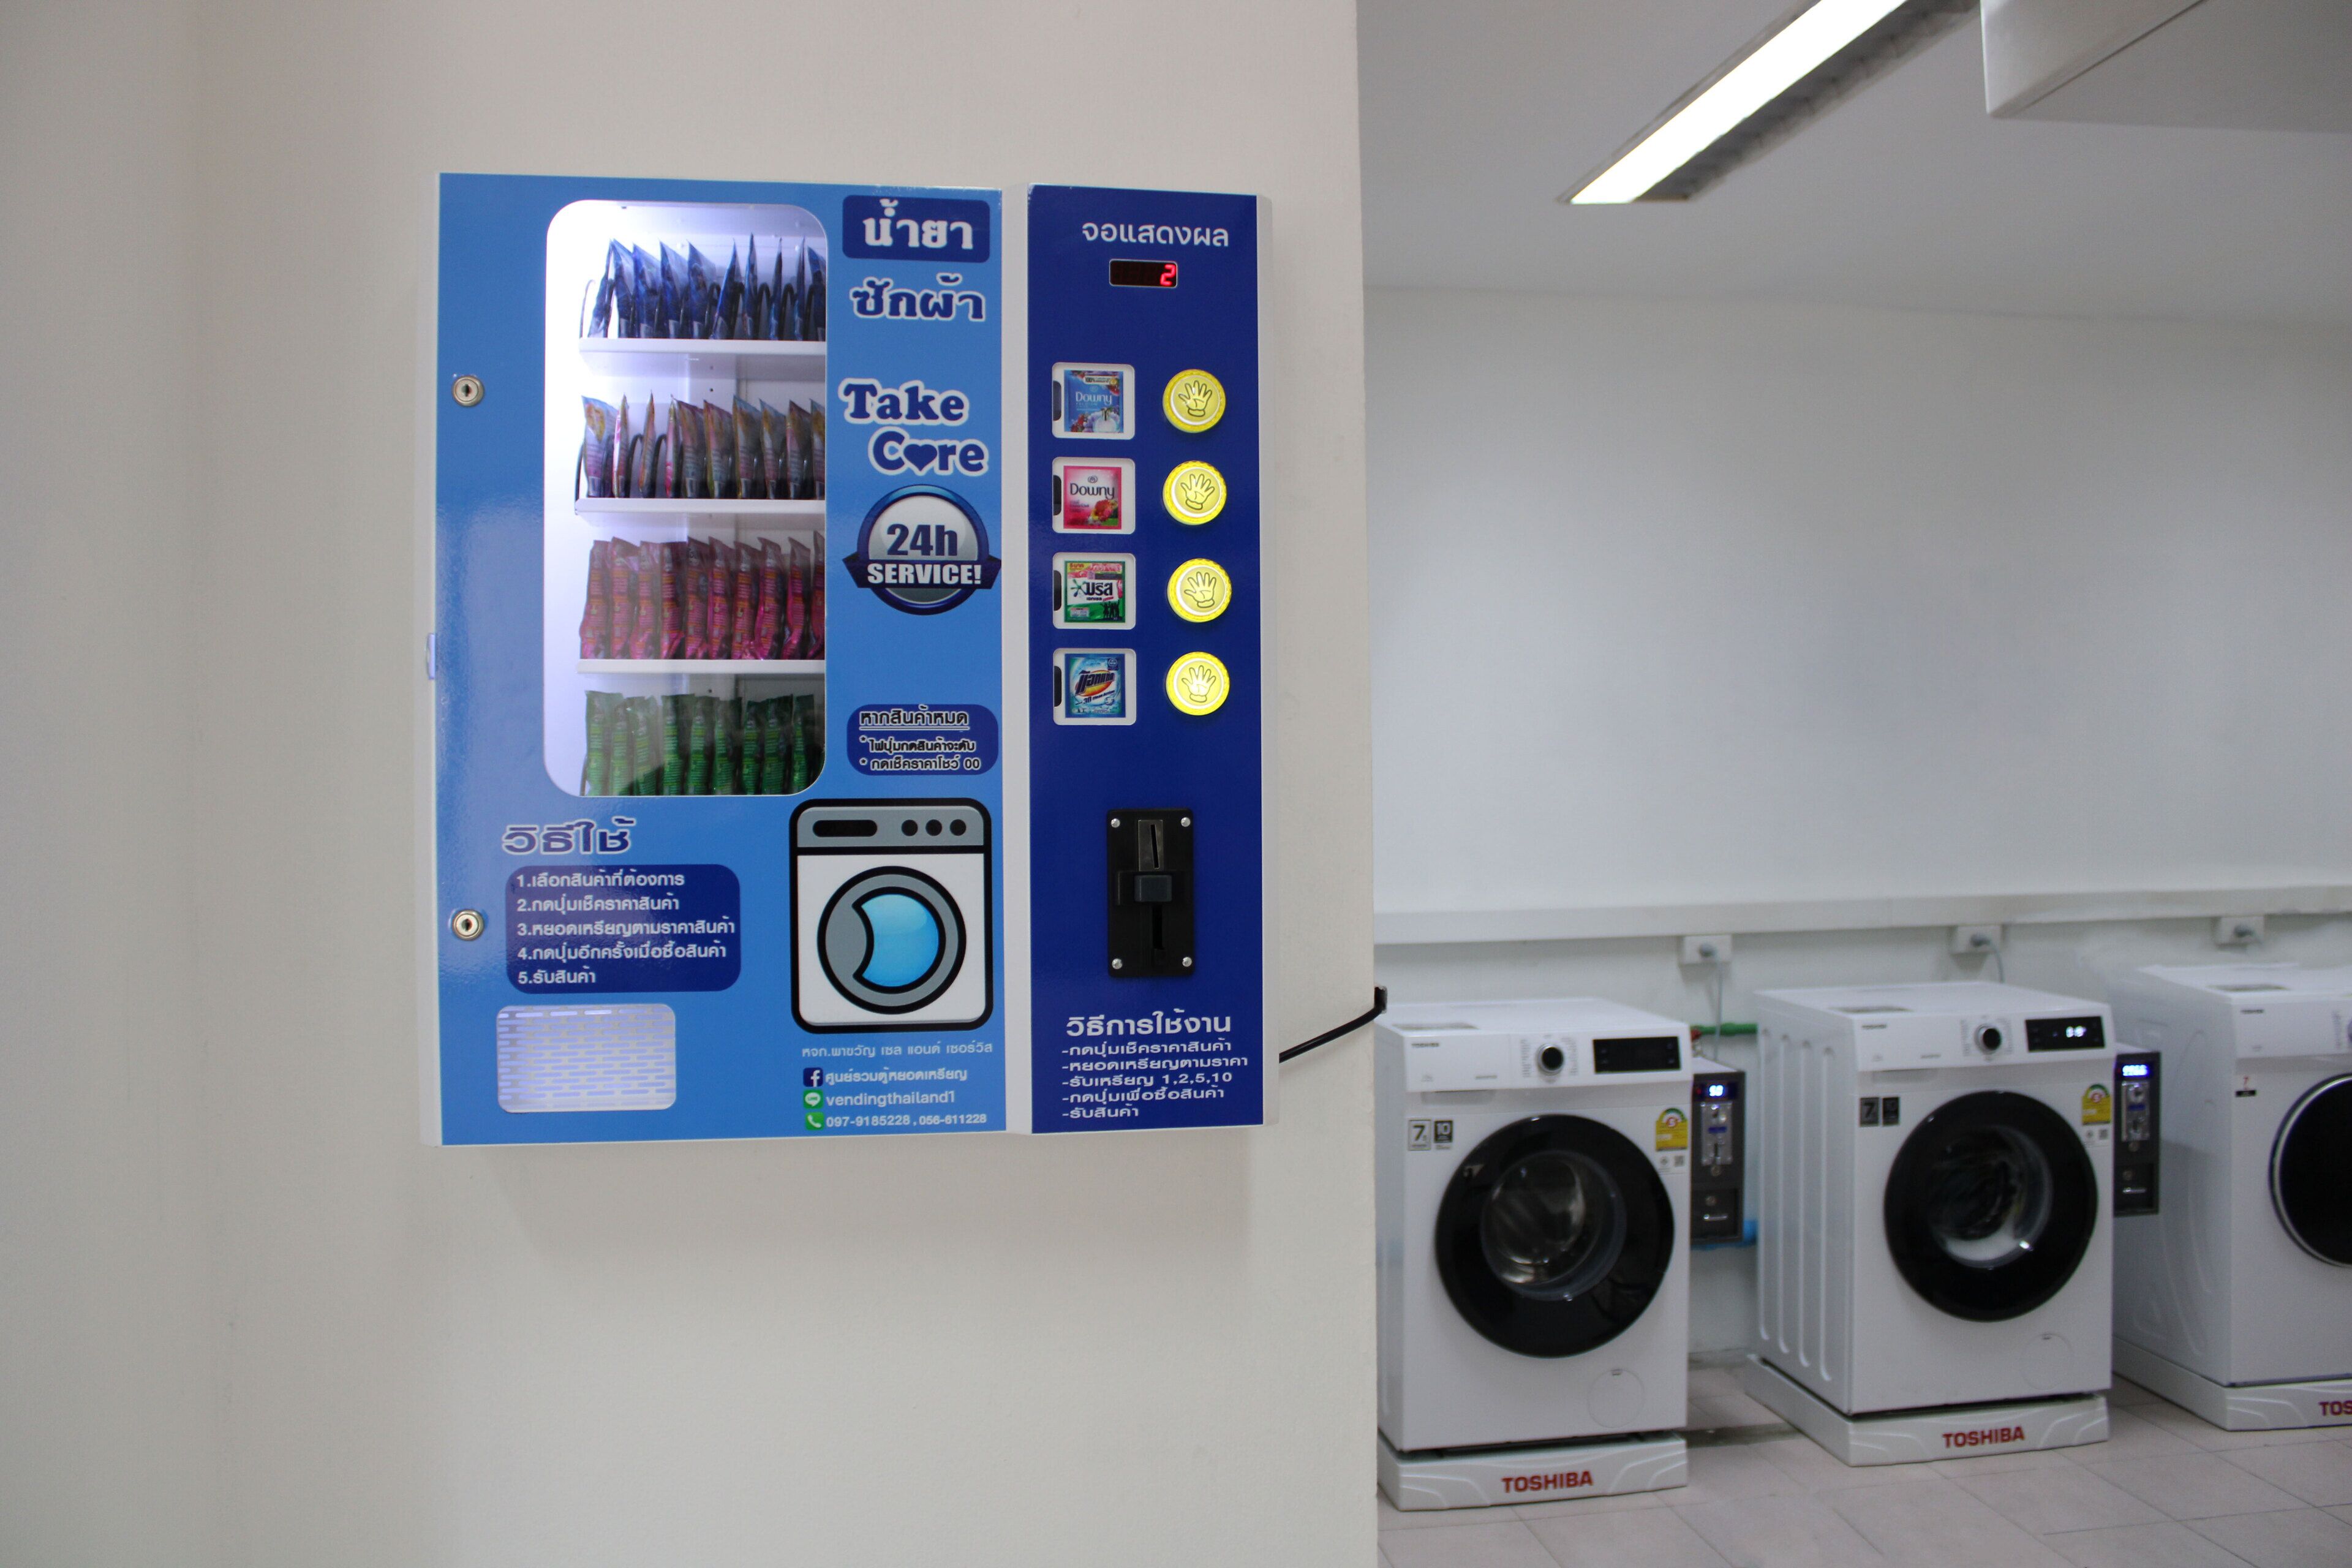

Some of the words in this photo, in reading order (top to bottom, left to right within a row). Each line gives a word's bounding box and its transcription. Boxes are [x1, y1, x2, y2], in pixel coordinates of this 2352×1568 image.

[862, 198, 974, 250] น้ำยา
[1082, 221, 1229, 247] จอแสดงผล
[1159, 263, 1177, 287] 2
[850, 271, 987, 322] ซักผ้า
[839, 377, 970, 425] Take
[1076, 391, 1112, 405] Downy
[1069, 483, 1115, 500] Downy
[886, 524, 959, 556] 24h
[867, 562, 981, 586] SERVICE!
[859, 704, 969, 726] หากสินค้าหมด
[869, 736, 976, 755] ไฟปุ่มกดสินค้าจะดับ
[870, 755, 960, 771] กดเช็คราคาโชว์
[963, 758, 981, 771] 00
[502, 816, 636, 854] วิธีใช้
[517, 869, 685, 888] 1.เลือกสินค้าที่ต้องการ
[517, 892, 679, 915] 2.กดปุ่มเช็คราคาสินค้า
[517, 916, 735, 937] 3.หยอดเหรียญตามราคาสินค้า
[518, 940, 726, 960] 4.กดปุ่มอีกครั้งเมื่อซื้อสินค้า
[518, 966, 596, 985] 5.รับสินค้า
[1066, 1008, 1231, 1036] วิธีการใช้งาน
[802, 1044, 876, 1058] หจก.พาขวัญ
[881, 1045, 902, 1055] เซล
[908, 1041, 940, 1054] แอนด์
[946, 1039, 993, 1054] เซอร์วิส
[1061, 1038, 1231, 1057] -กดปุ่มเช็คราคาสินค้า
[1061, 1057, 1248, 1072] -หยอดเหรียญตามราคา
[825, 1067, 967, 1085] ศูนย์รวมตู้หยอดเหรียญ
[1061, 1074, 1153, 1087] -รับเหรียญ
[1162, 1072, 1232, 1086] 1,2,5,10
[825, 1091, 956, 1107] vendingthailand1
[1061, 1085, 1224, 1104] -กดปุ่มเพื่อซื้อสินค้า
[826, 1115, 910, 1128] 097-9185228
[919, 1114, 987, 1125] 056-611228
[1061, 1104, 1139, 1119] -รับสินค้า
[1412, 1123, 1425, 1141] 7
[1942, 1426, 2025, 1448] TOSHIBA
[1501, 1470, 1594, 1493] TOSHIBA
